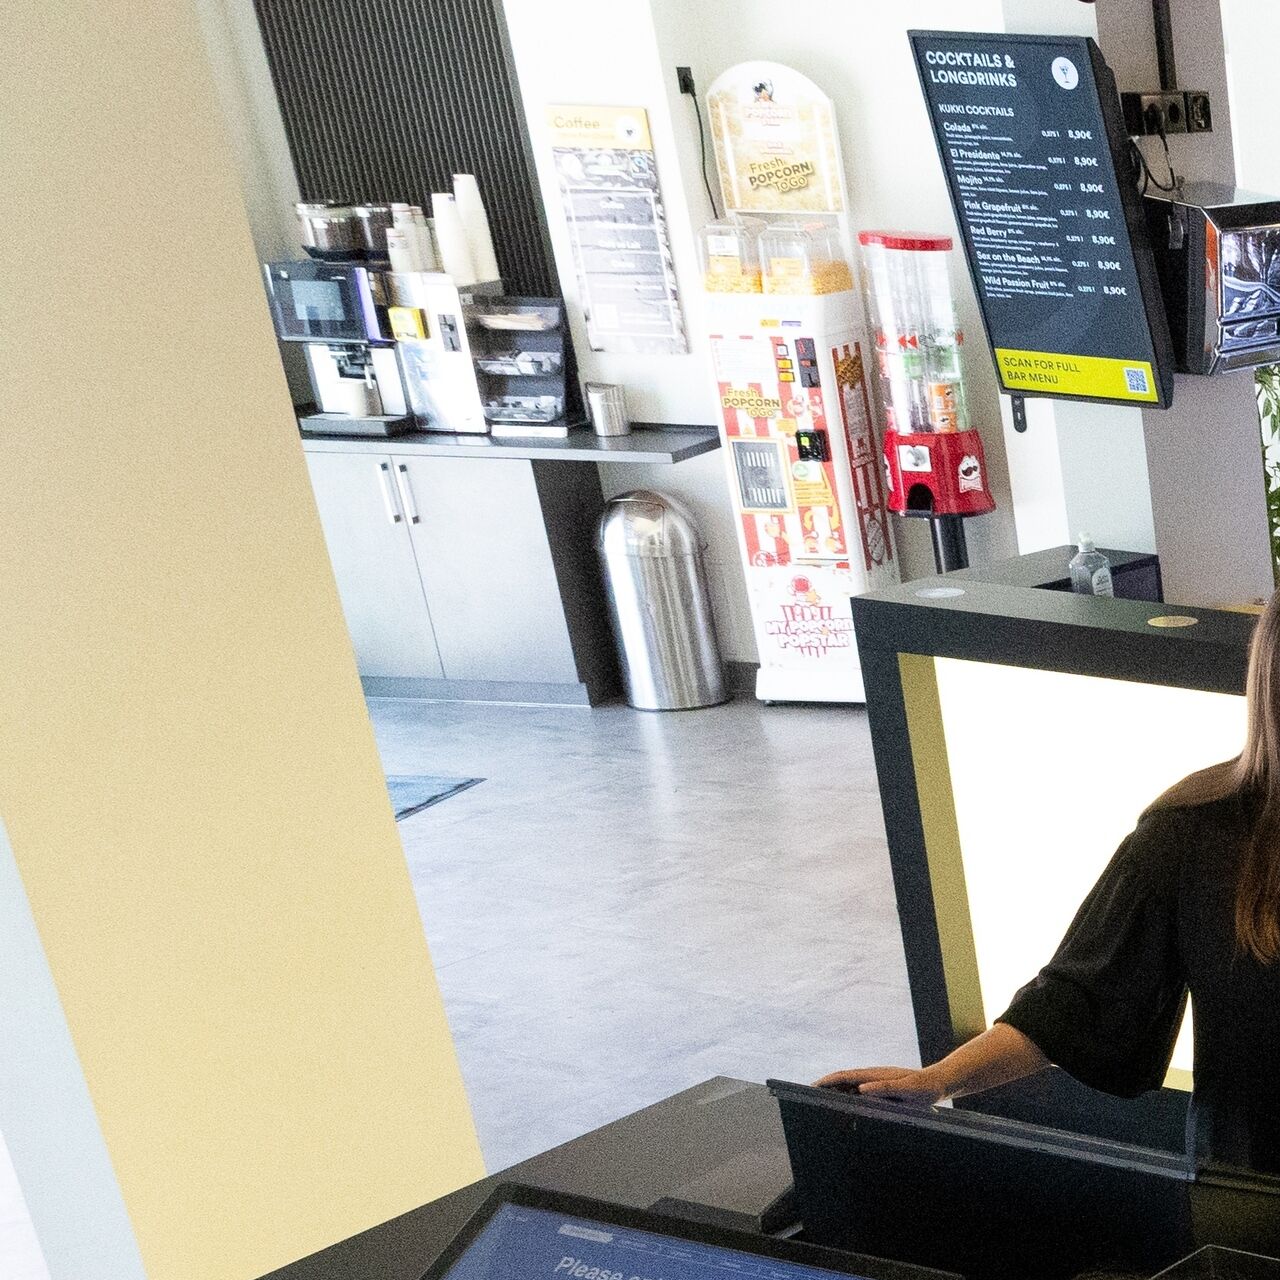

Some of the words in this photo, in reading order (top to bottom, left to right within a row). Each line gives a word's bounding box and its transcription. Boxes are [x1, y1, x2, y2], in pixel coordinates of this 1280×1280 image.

[925, 51, 1002, 68] COCKTAILS
[1004, 54, 1016, 69] &
[930, 69, 1017, 87] LONGDRINKS
[938, 103, 965, 114] KUKKI
[966, 105, 1015, 117] COCKTAILS
[553, 115, 600, 130] Coffee
[943, 122, 972, 133] Colada
[959, 149, 1000, 160] Presidente
[749, 157, 783, 173] Fresh
[748, 160, 810, 186] POPCORN
[957, 175, 983, 185] Mojito
[963, 201, 981, 210] Pink
[981, 202, 1023, 213] Grapefruit
[970, 226, 986, 235] Red
[986, 228, 1007, 238] Berry
[976, 251, 991, 260] Sex
[992, 253, 1002, 261] on
[1002, 253, 1016, 262] the
[1016, 254, 1041, 264] Beach
[983, 276, 1001, 286] Wild
[1002, 278, 1031, 288] Passion
[1031, 280, 1050, 289] Fruit
[1003, 357, 1032, 368] SCAN
[1034, 359, 1054, 370] FOR
[1056, 361, 1080, 373] FULL
[1007, 371, 1026, 381] BAR
[1028, 373, 1059, 384] MENU
[726, 388, 757, 397] Fresh
[723, 398, 780, 407] POPCORN
